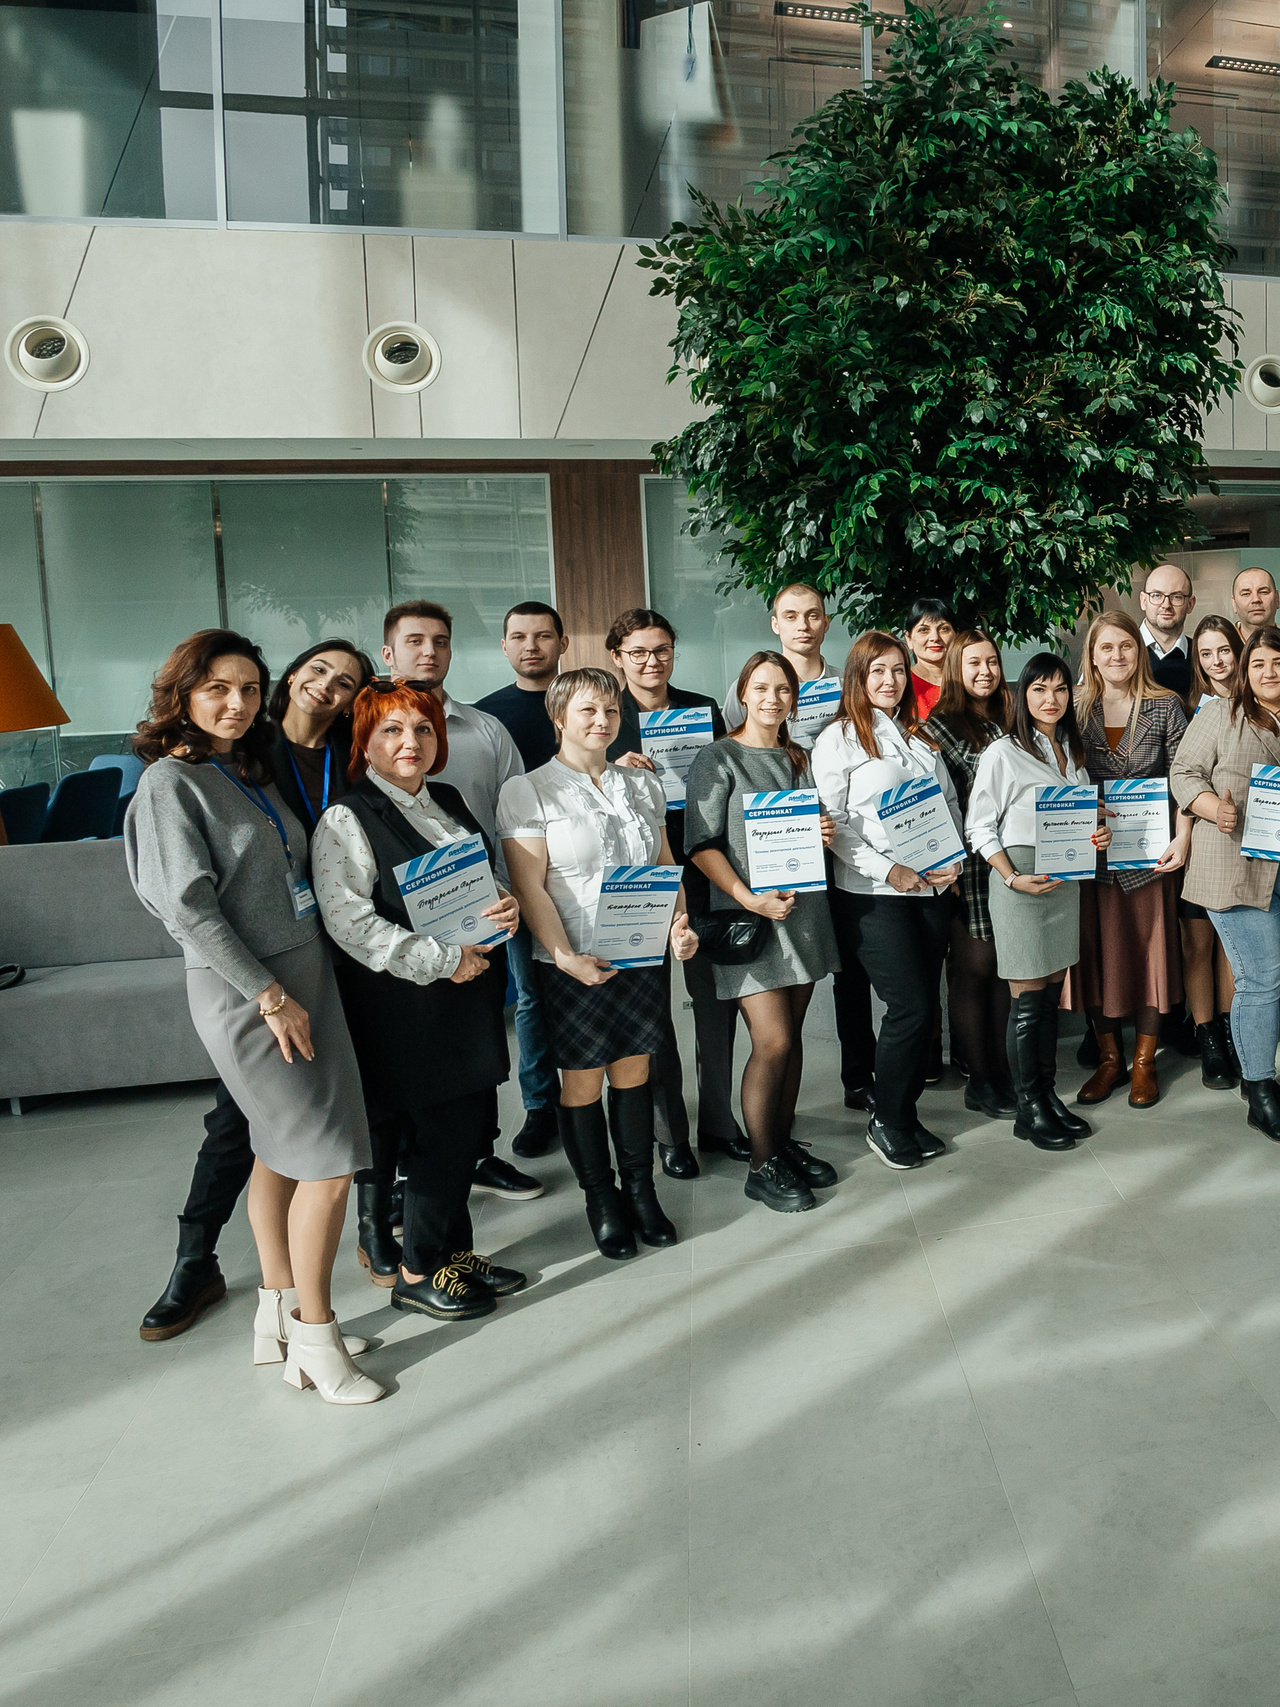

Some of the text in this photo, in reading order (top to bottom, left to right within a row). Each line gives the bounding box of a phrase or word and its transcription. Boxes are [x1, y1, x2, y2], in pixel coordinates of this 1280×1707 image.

[797, 696, 820, 705] ИФИКАТ
[644, 726, 687, 736] СЕРТИФИКАТ
[881, 795, 919, 817] СЕРТИФИКАТ
[748, 808, 793, 818] СЕРТИФИКАТ
[405, 863, 456, 891] СЕРТИФИКАТ
[605, 883, 652, 891] СЕРТИФИКАТ
